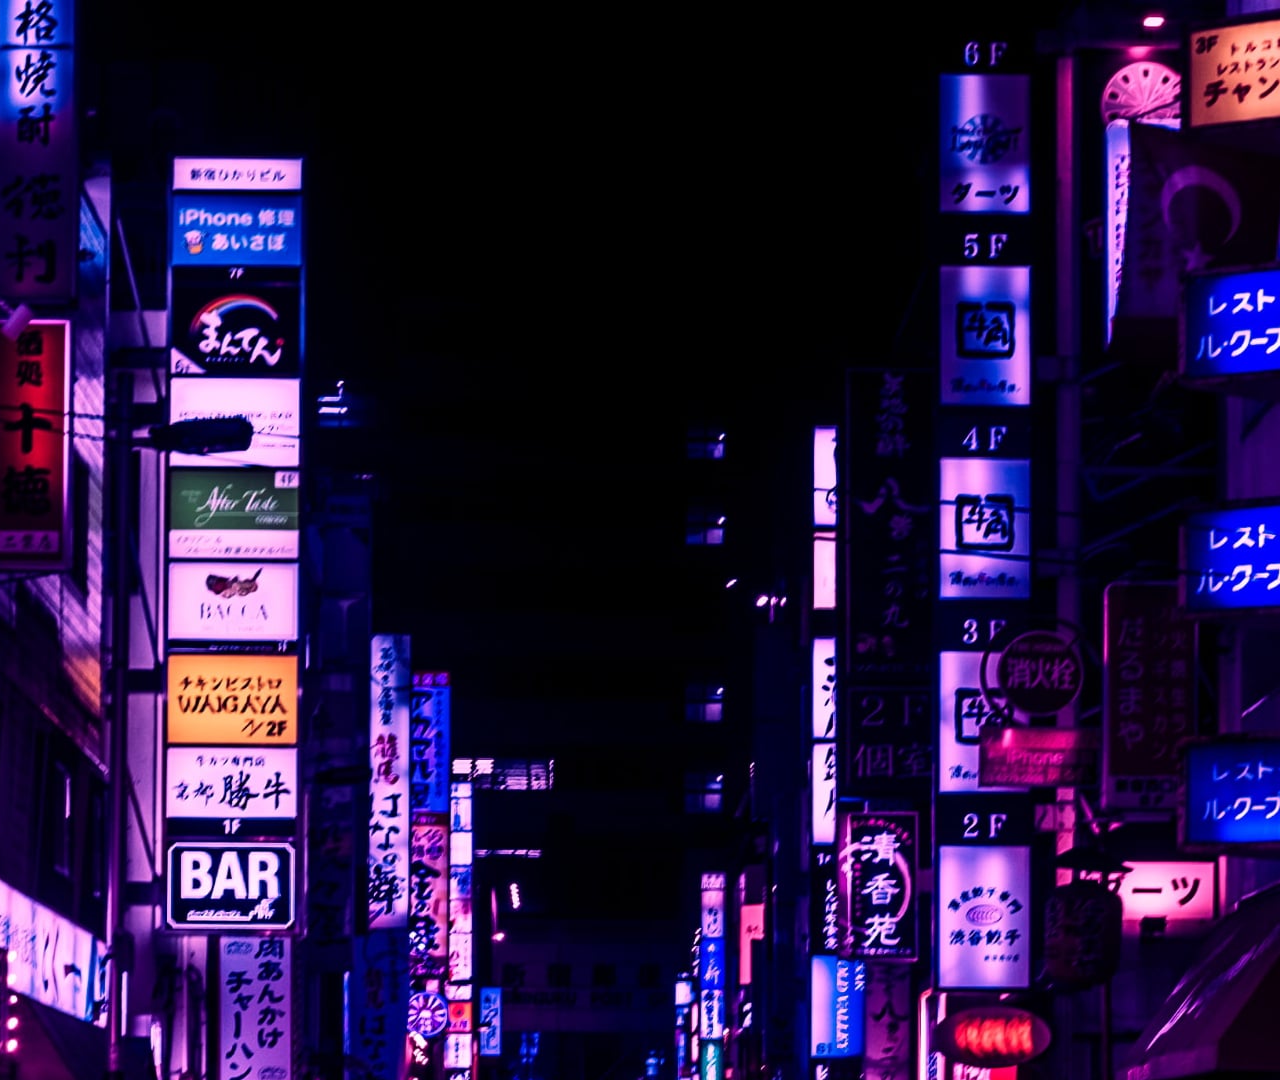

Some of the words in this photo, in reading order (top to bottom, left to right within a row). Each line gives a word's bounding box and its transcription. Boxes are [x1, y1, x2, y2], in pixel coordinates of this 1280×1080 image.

[178, 208, 254, 227] iPhone
[198, 310, 284, 366] まんてん
[180, 675, 285, 692] チキンビストロ
[1005, 656, 1075, 691] 消火栓
[266, 719, 288, 737] 2F
[221, 818, 242, 835] 1F
[180, 850, 282, 900] BAR
[858, 831, 901, 949] 清香苑
[254, 939, 287, 1049] 肉あんかけ
